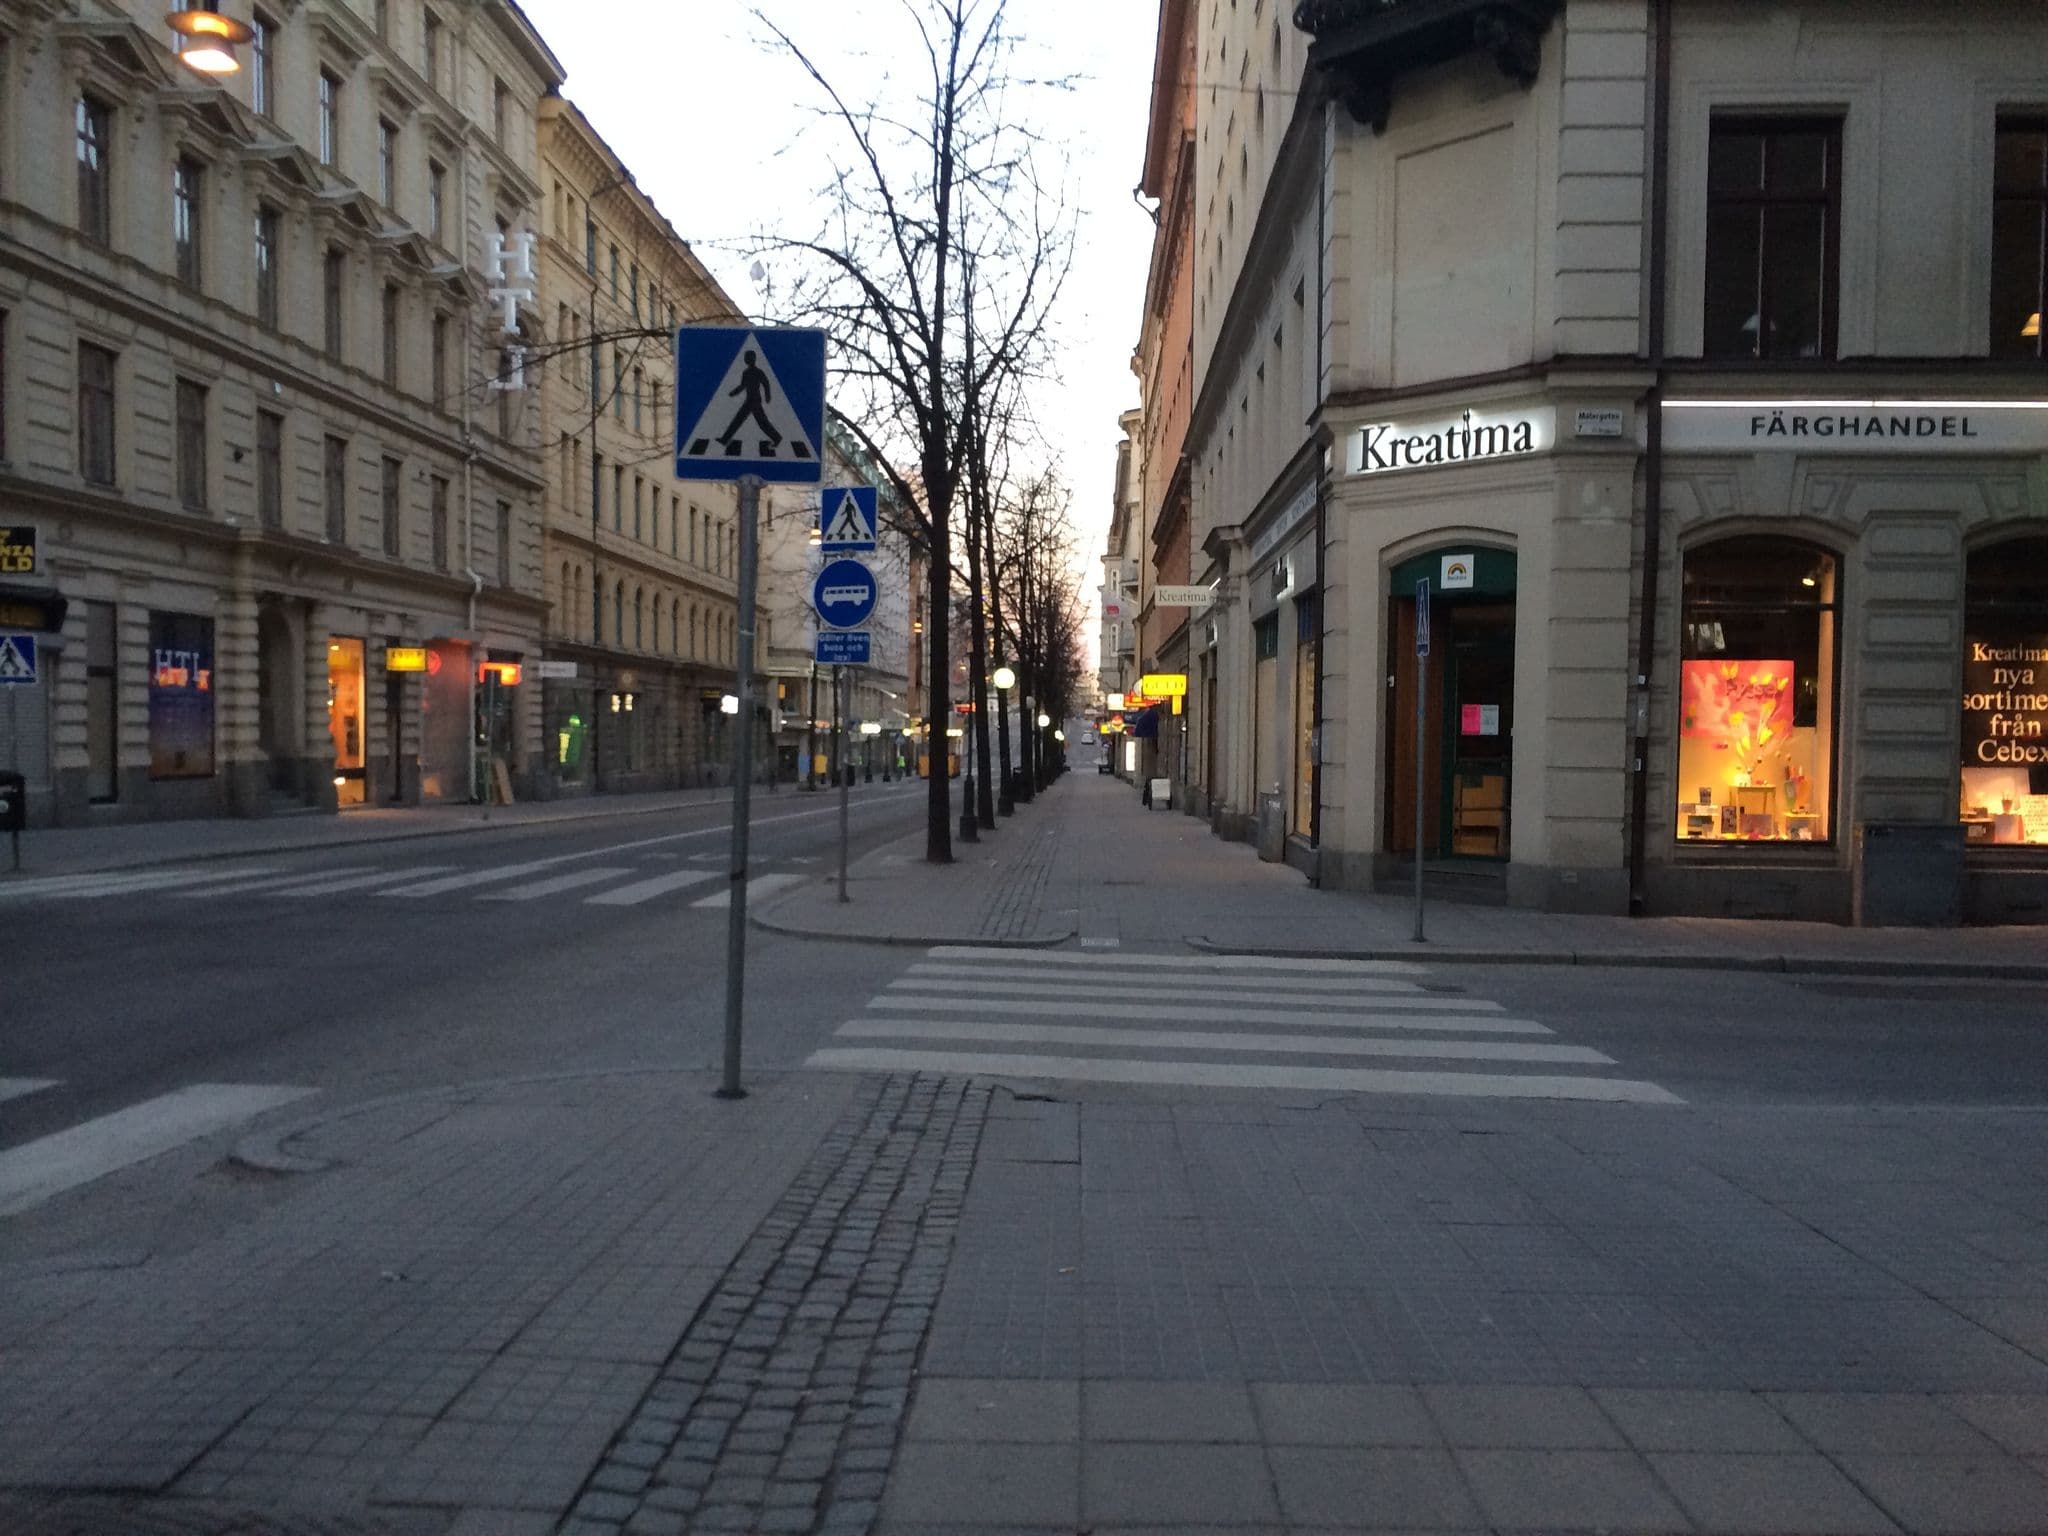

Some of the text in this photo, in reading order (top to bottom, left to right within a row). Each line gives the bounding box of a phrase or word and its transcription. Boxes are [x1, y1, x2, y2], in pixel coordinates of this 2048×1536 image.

[1751, 410, 1977, 437] FÄRGHANDEL
[1357, 408, 1534, 472] Kreatima
[1158, 589, 1207, 602] Kreatima
[1993, 667, 2035, 690] nya
[1989, 713, 2042, 737] från
